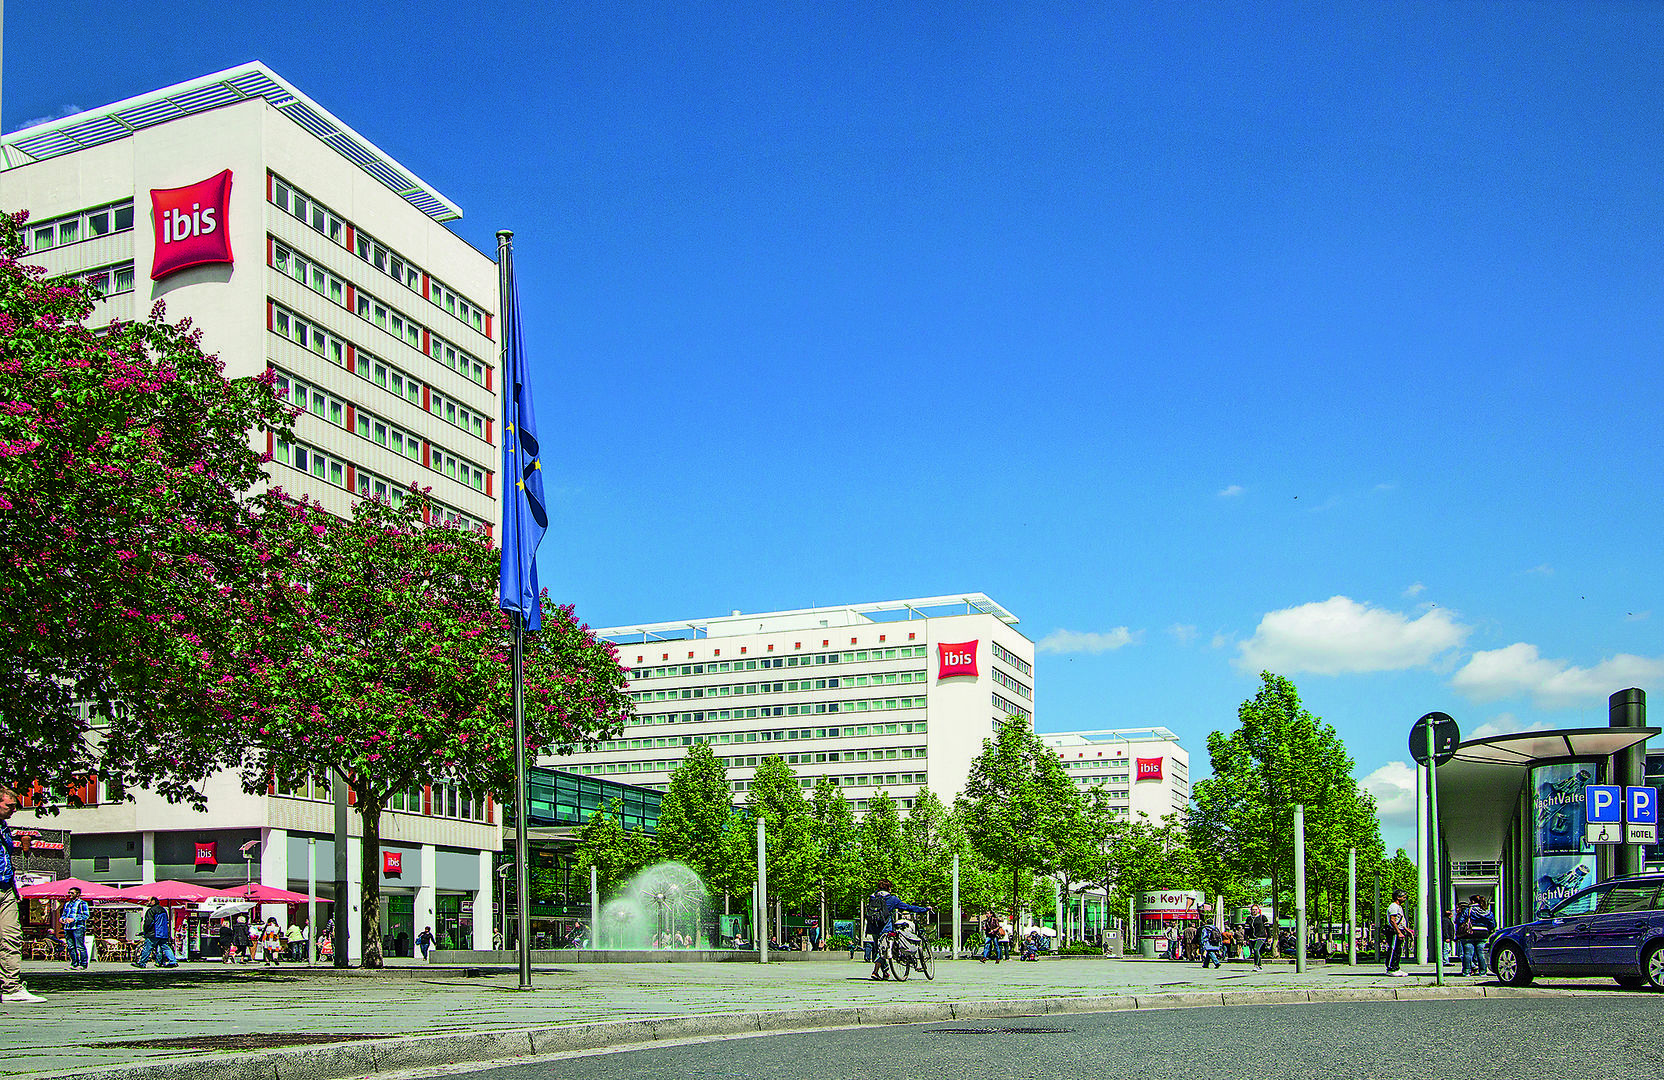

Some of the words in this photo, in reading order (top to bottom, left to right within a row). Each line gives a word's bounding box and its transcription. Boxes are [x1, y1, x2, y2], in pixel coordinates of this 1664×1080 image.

[163, 202, 217, 244] ibis
[944, 651, 973, 666] ibis
[1140, 763, 1160, 773] ibis
[1534, 792, 1585, 809] NachtValte
[1594, 790, 1613, 818] P
[1633, 791, 1650, 818] P
[1630, 830, 1654, 839] HOTEL
[34, 840, 64, 849] Pizza
[197, 848, 212, 858] ibis
[387, 857, 400, 867] ibis
[1142, 893, 1156, 904] Eis
[1160, 893, 1183, 905] Keyl
